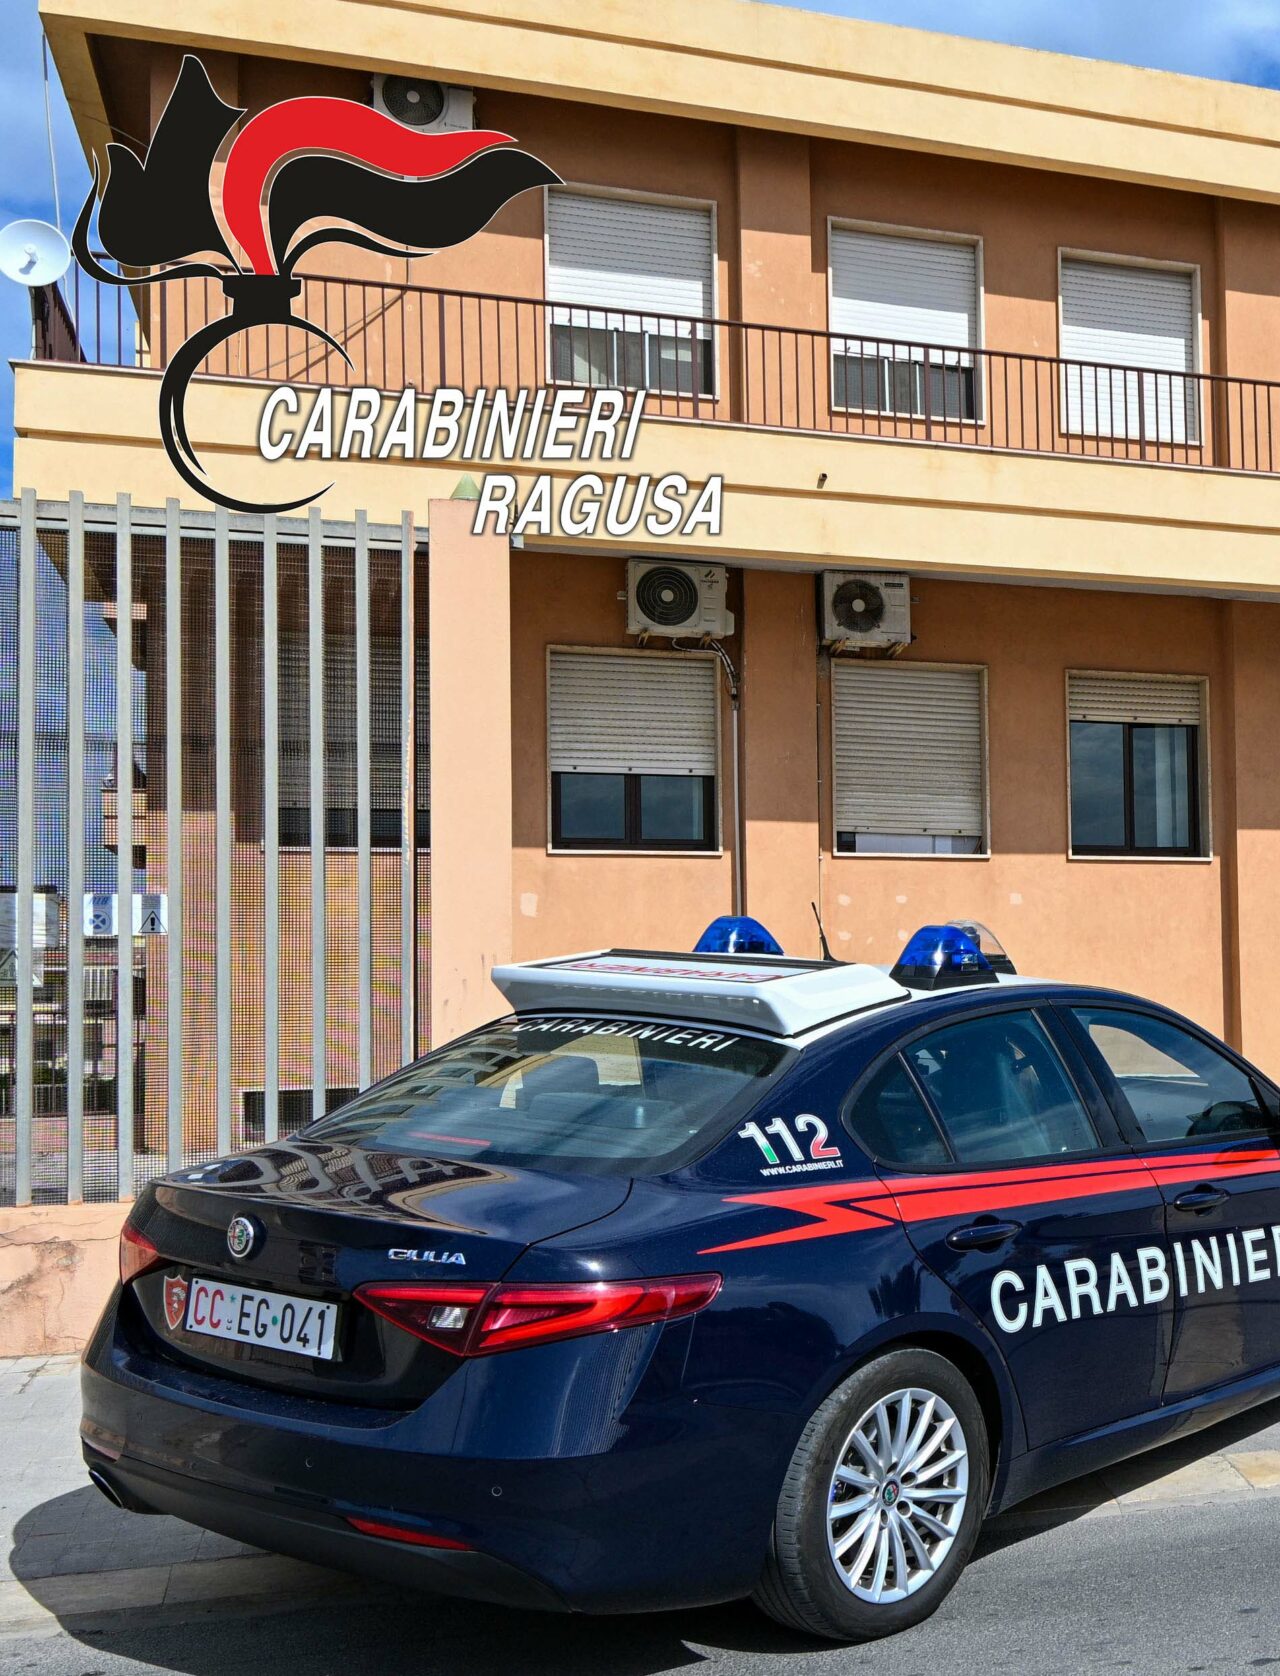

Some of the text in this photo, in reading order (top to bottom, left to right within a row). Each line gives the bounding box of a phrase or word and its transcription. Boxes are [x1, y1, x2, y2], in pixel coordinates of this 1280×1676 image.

[512, 1018, 740, 1052] CARABINIERI
[737, 1113, 842, 1165] 112
[759, 1159, 844, 1177] WWW.CARABINIERI.IT
[388, 1248, 466, 1265] GIULIA
[193, 1286, 225, 1329] CC
